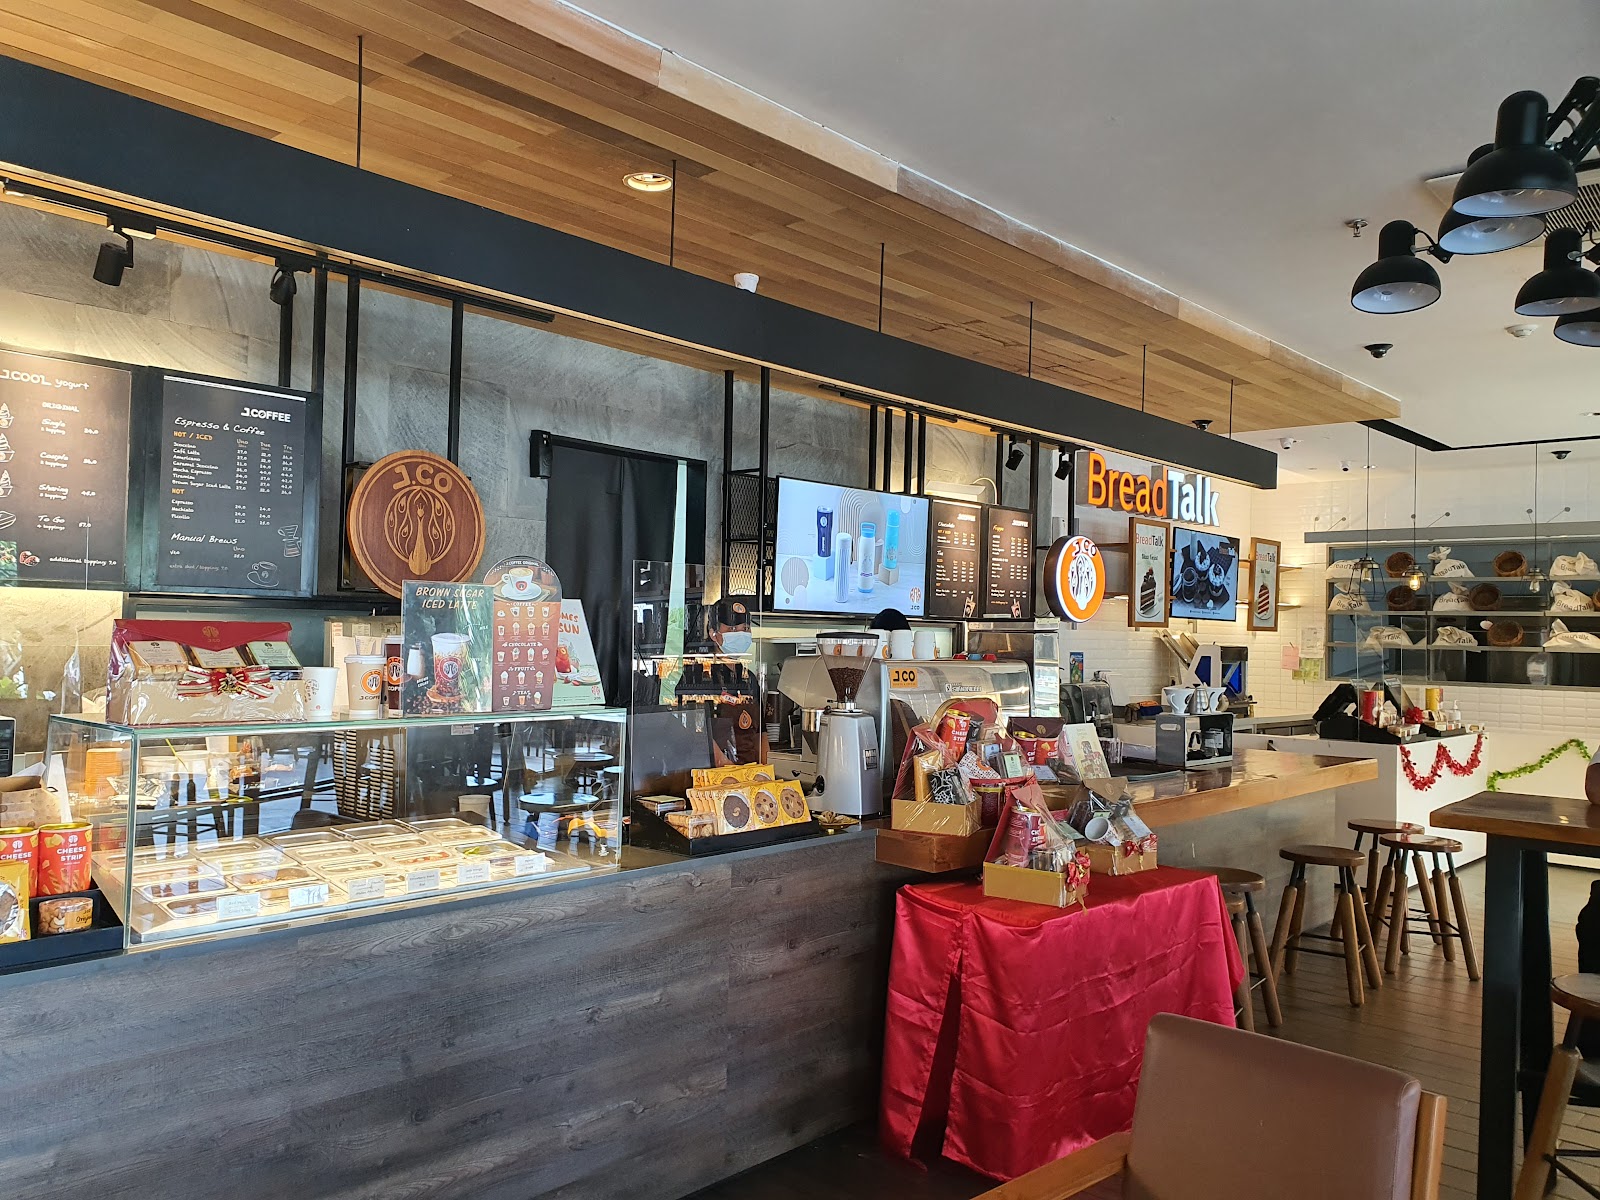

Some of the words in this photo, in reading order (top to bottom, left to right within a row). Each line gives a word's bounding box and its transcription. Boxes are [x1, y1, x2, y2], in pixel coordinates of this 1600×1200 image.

[55, 379, 90, 390] yogurt
[42, 402, 79, 412] ORIGINAL
[241, 407, 292, 422] J.COFFEE
[174, 417, 219, 430] Espresso
[223, 423, 229, 431] &
[234, 425, 265, 436] Coffee
[39, 484, 69, 495] Sharing
[1087, 452, 1220, 527] BreadTalk
[171, 533, 206, 543] Manual
[209, 535, 238, 544] Brews
[1135, 532, 1164, 547] BreadTalk
[49, 556, 82, 564] additional
[415, 587, 449, 597] BROWN
[454, 588, 485, 598] SUGAR
[421, 599, 445, 609] ICED
[448, 600, 477, 610] LATTE
[0, 852, 32, 860] CHEESE
[60, 854, 84, 862] STRIP
